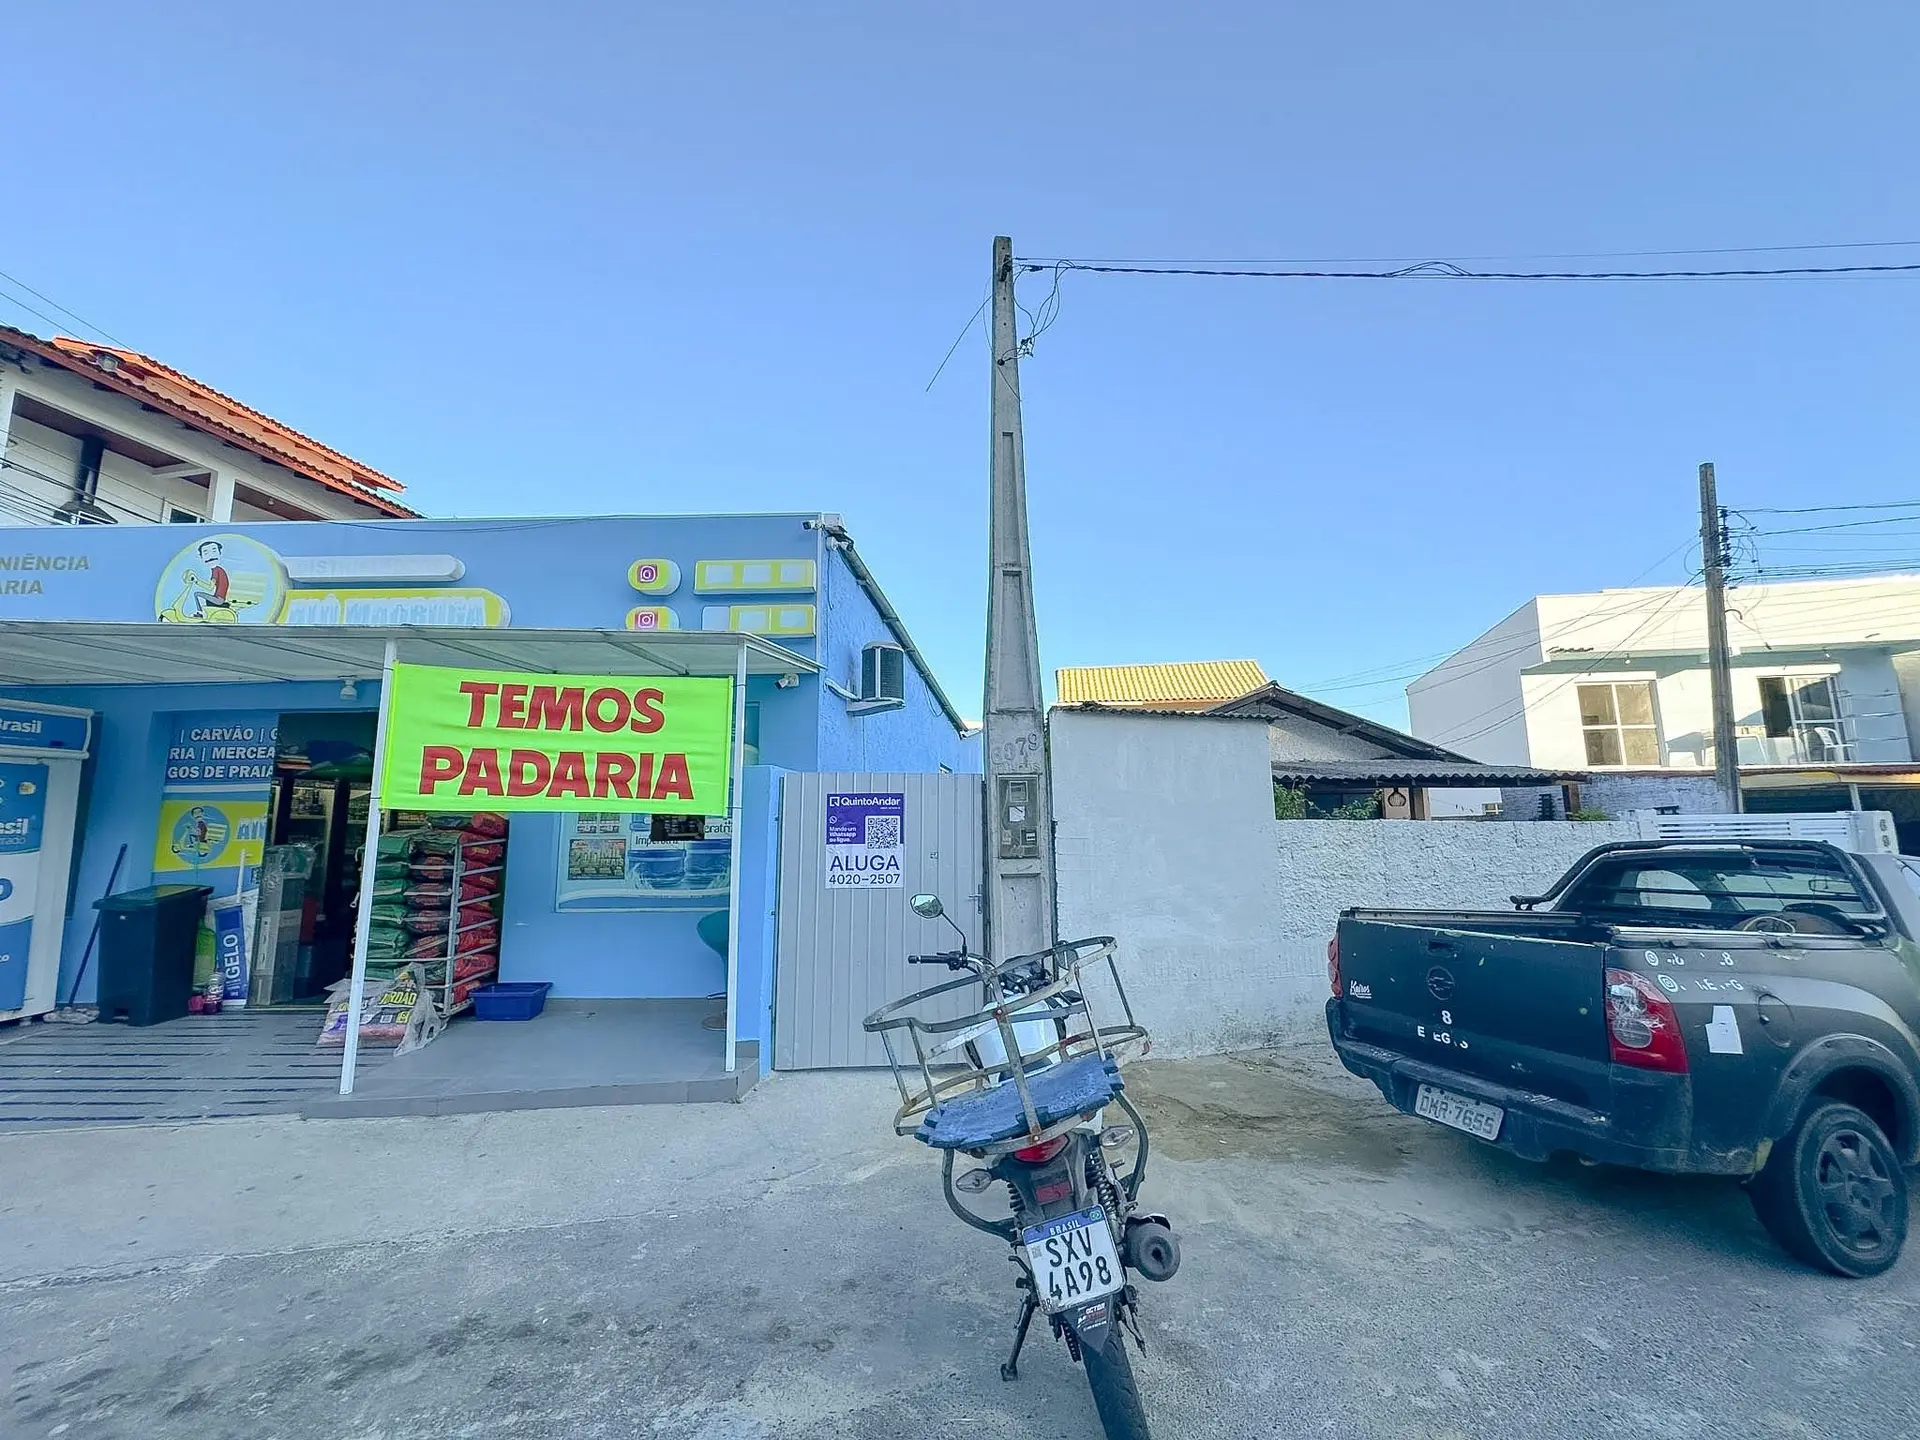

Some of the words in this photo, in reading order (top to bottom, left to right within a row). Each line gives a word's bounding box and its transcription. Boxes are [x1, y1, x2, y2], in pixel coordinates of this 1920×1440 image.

[0, 579, 43, 595] RIA
[459, 681, 665, 734] TEMOS
[191, 724, 254, 741] CARVÃO
[169, 748, 195, 759] RIA
[167, 767, 200, 778] GOS
[204, 766, 224, 778] DE
[228, 766, 273, 778] PRAIA
[419, 745, 695, 800] PADARIA
[841, 797, 901, 807] QuintoAndar
[829, 855, 900, 871] ALUGA
[828, 874, 900, 885] 4020-2507
[223, 934, 240, 981] GELO
[1441, 1010, 1453, 1025] 8
[1050, 1219, 1082, 1236] BRASIL
[1045, 1227, 1093, 1267] SXV
[1049, 1256, 1112, 1300] 4A98
